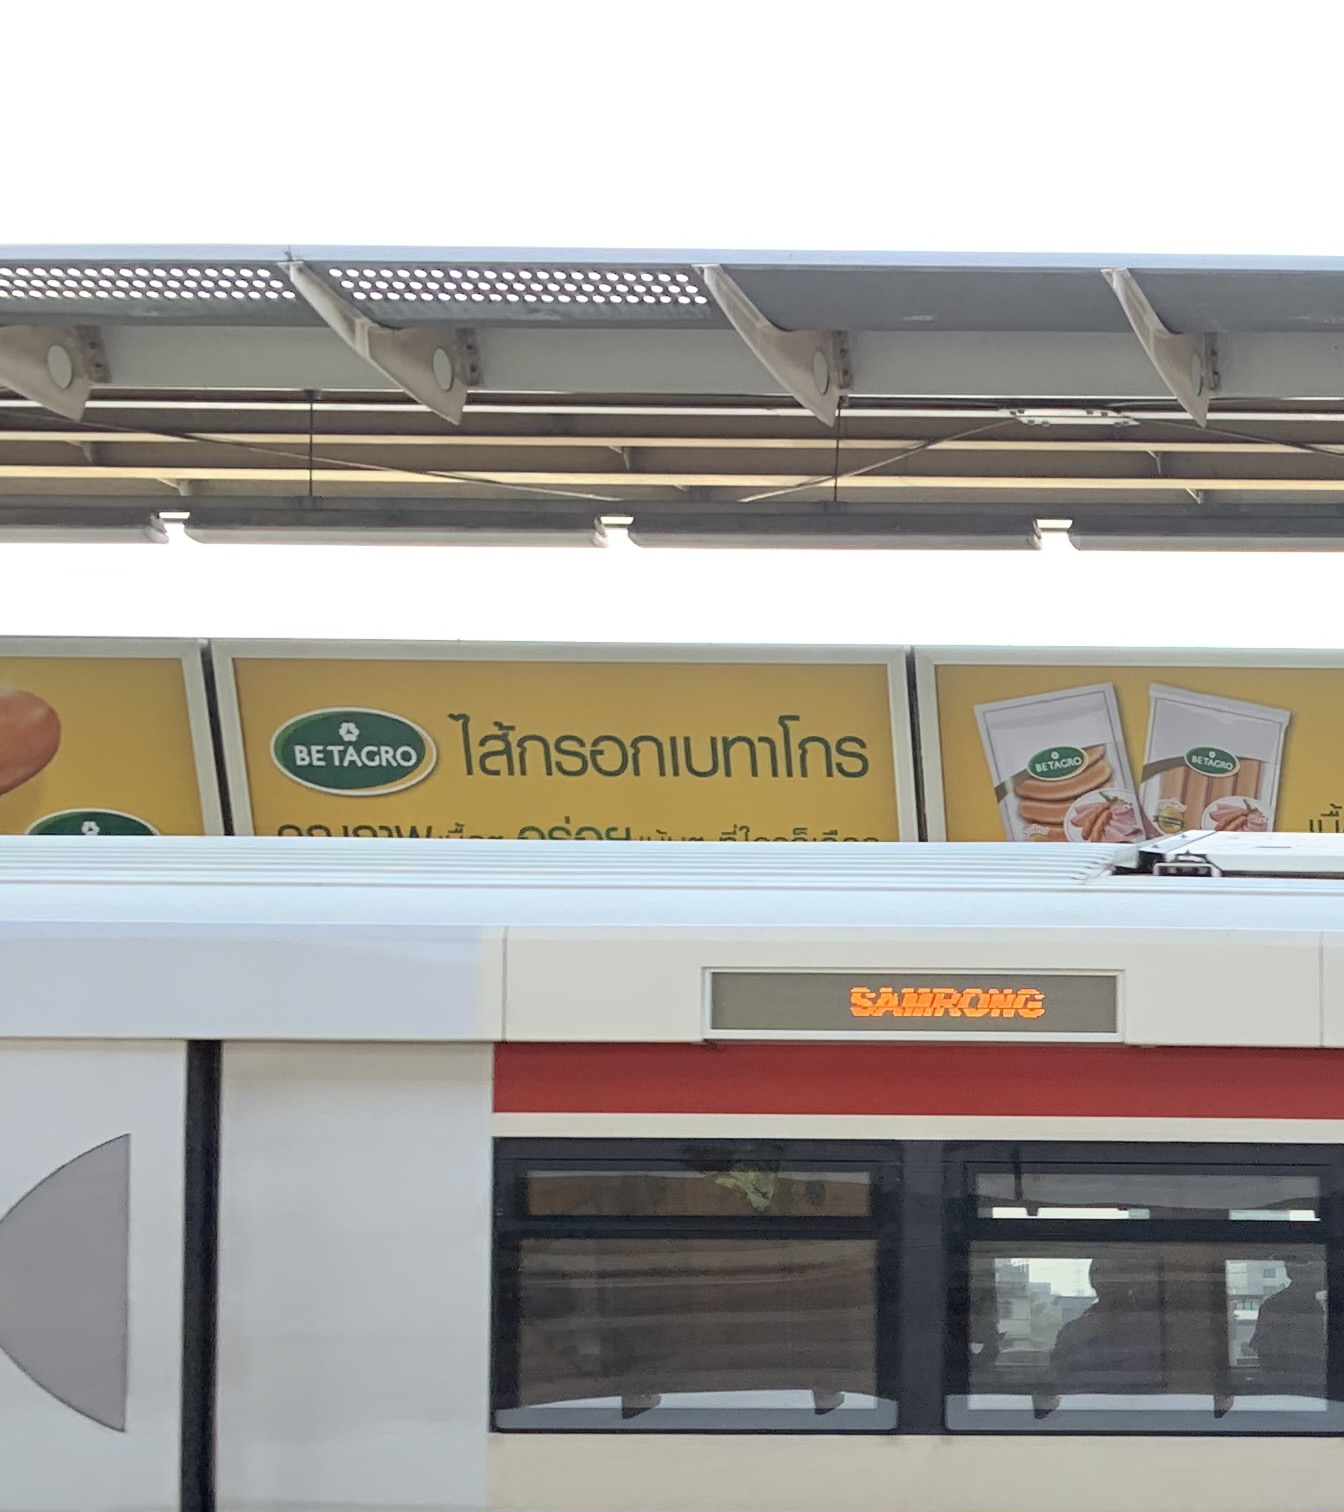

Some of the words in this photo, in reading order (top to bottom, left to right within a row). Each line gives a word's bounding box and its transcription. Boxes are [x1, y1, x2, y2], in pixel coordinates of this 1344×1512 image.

[294, 744, 417, 769] BETAGRO
[447, 713, 871, 781] ไส้กรอกเบทาโกร
[1035, 756, 1083, 773] BETAGRO
[1190, 755, 1234, 771] BETAGRO
[847, 987, 1046, 1019] SAMRONG
